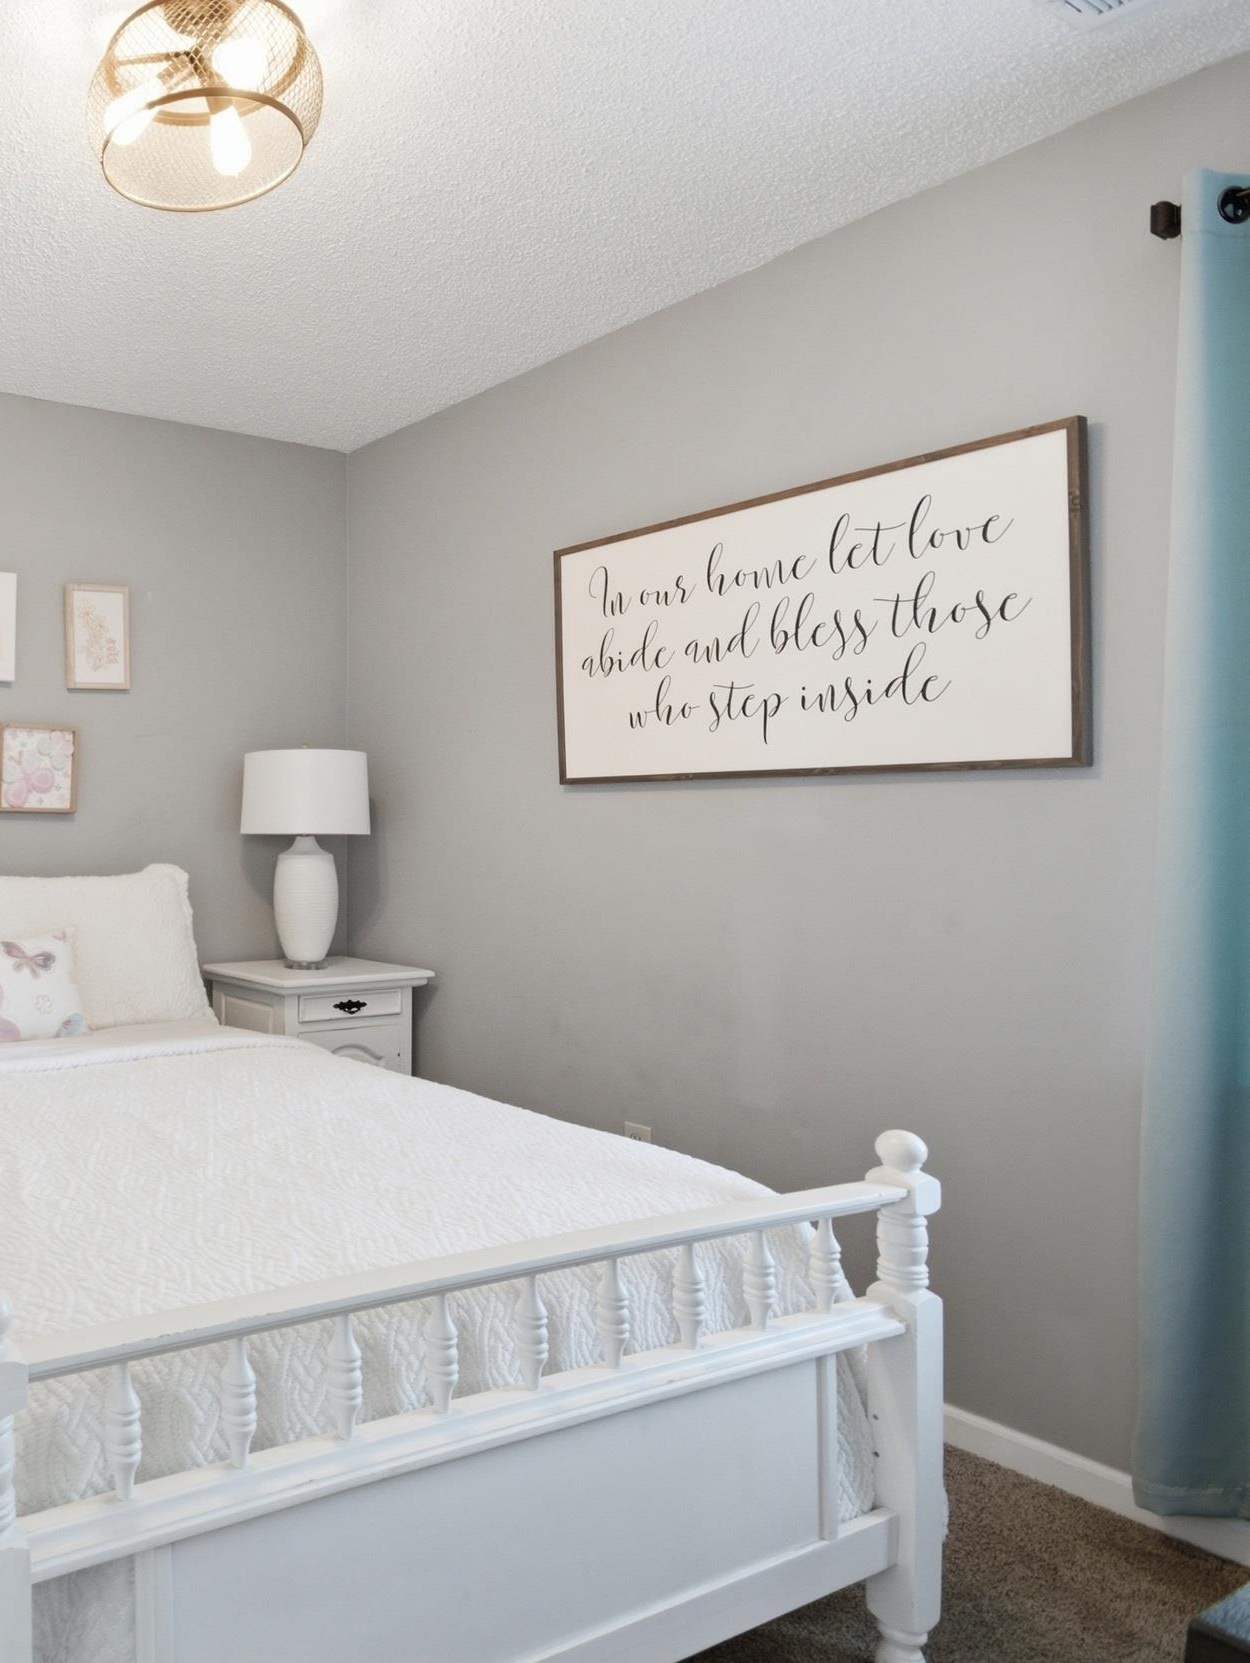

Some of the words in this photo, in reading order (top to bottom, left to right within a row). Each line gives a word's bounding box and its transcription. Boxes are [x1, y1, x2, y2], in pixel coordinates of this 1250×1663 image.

[588, 565, 632, 618] In
[639, 574, 698, 607] our
[706, 542, 818, 597] home
[829, 512, 907, 575] let
[908, 494, 1015, 559] love
[581, 619, 676, 678] abide
[684, 601, 761, 664] and
[770, 592, 879, 661] bless
[872, 570, 1033, 640] those
[629, 674, 701, 729] who
[708, 681, 790, 746] step
[801, 642, 953, 723] inside
